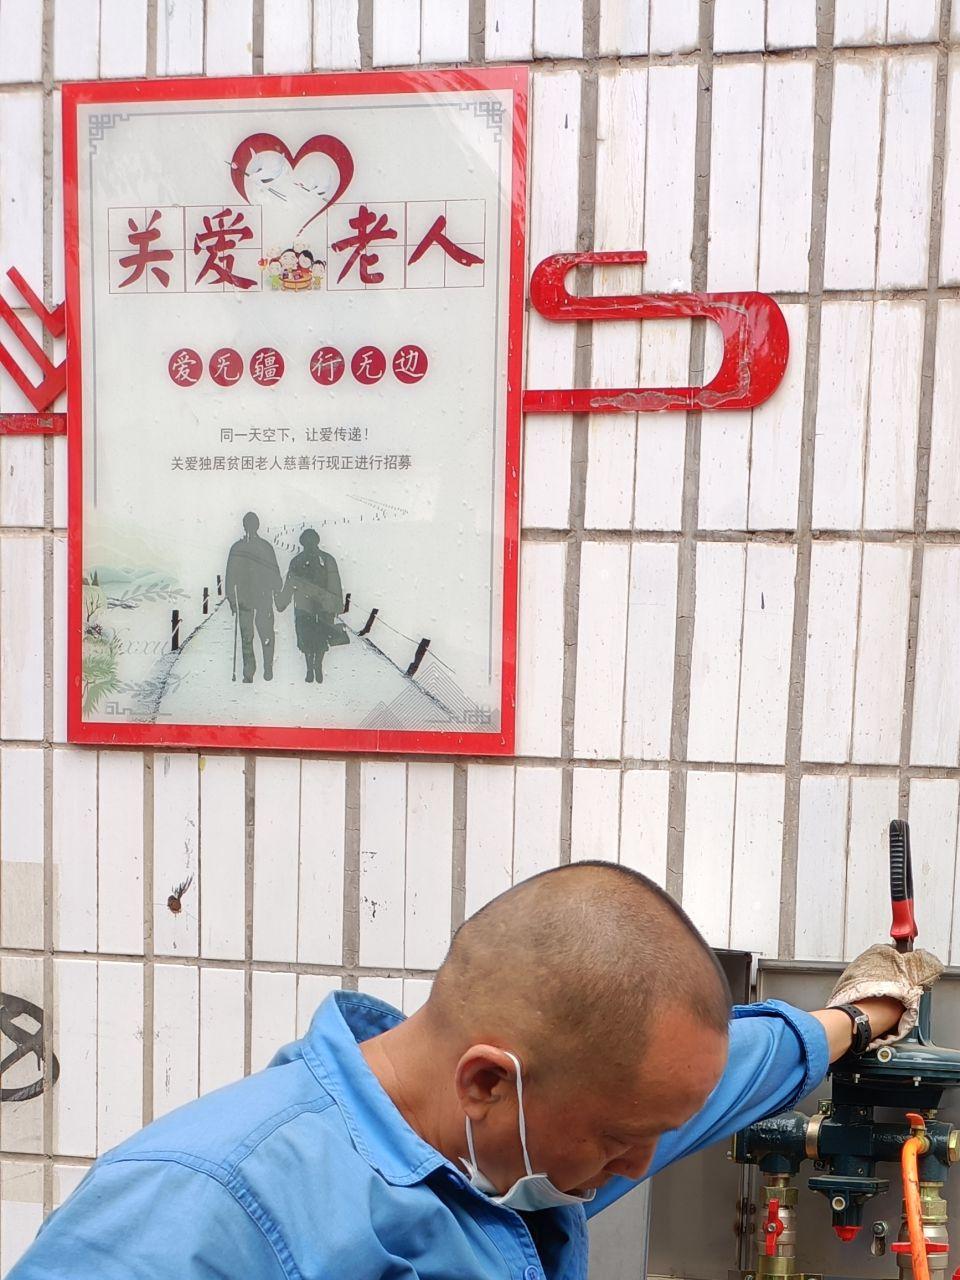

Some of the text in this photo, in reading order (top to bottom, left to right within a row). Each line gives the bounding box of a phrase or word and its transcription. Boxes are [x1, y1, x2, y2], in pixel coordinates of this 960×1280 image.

[119, 205, 484, 289] 关爱 老人
[171, 454, 413, 471] 关爱独居贫困老人慈善行现正进行招募
